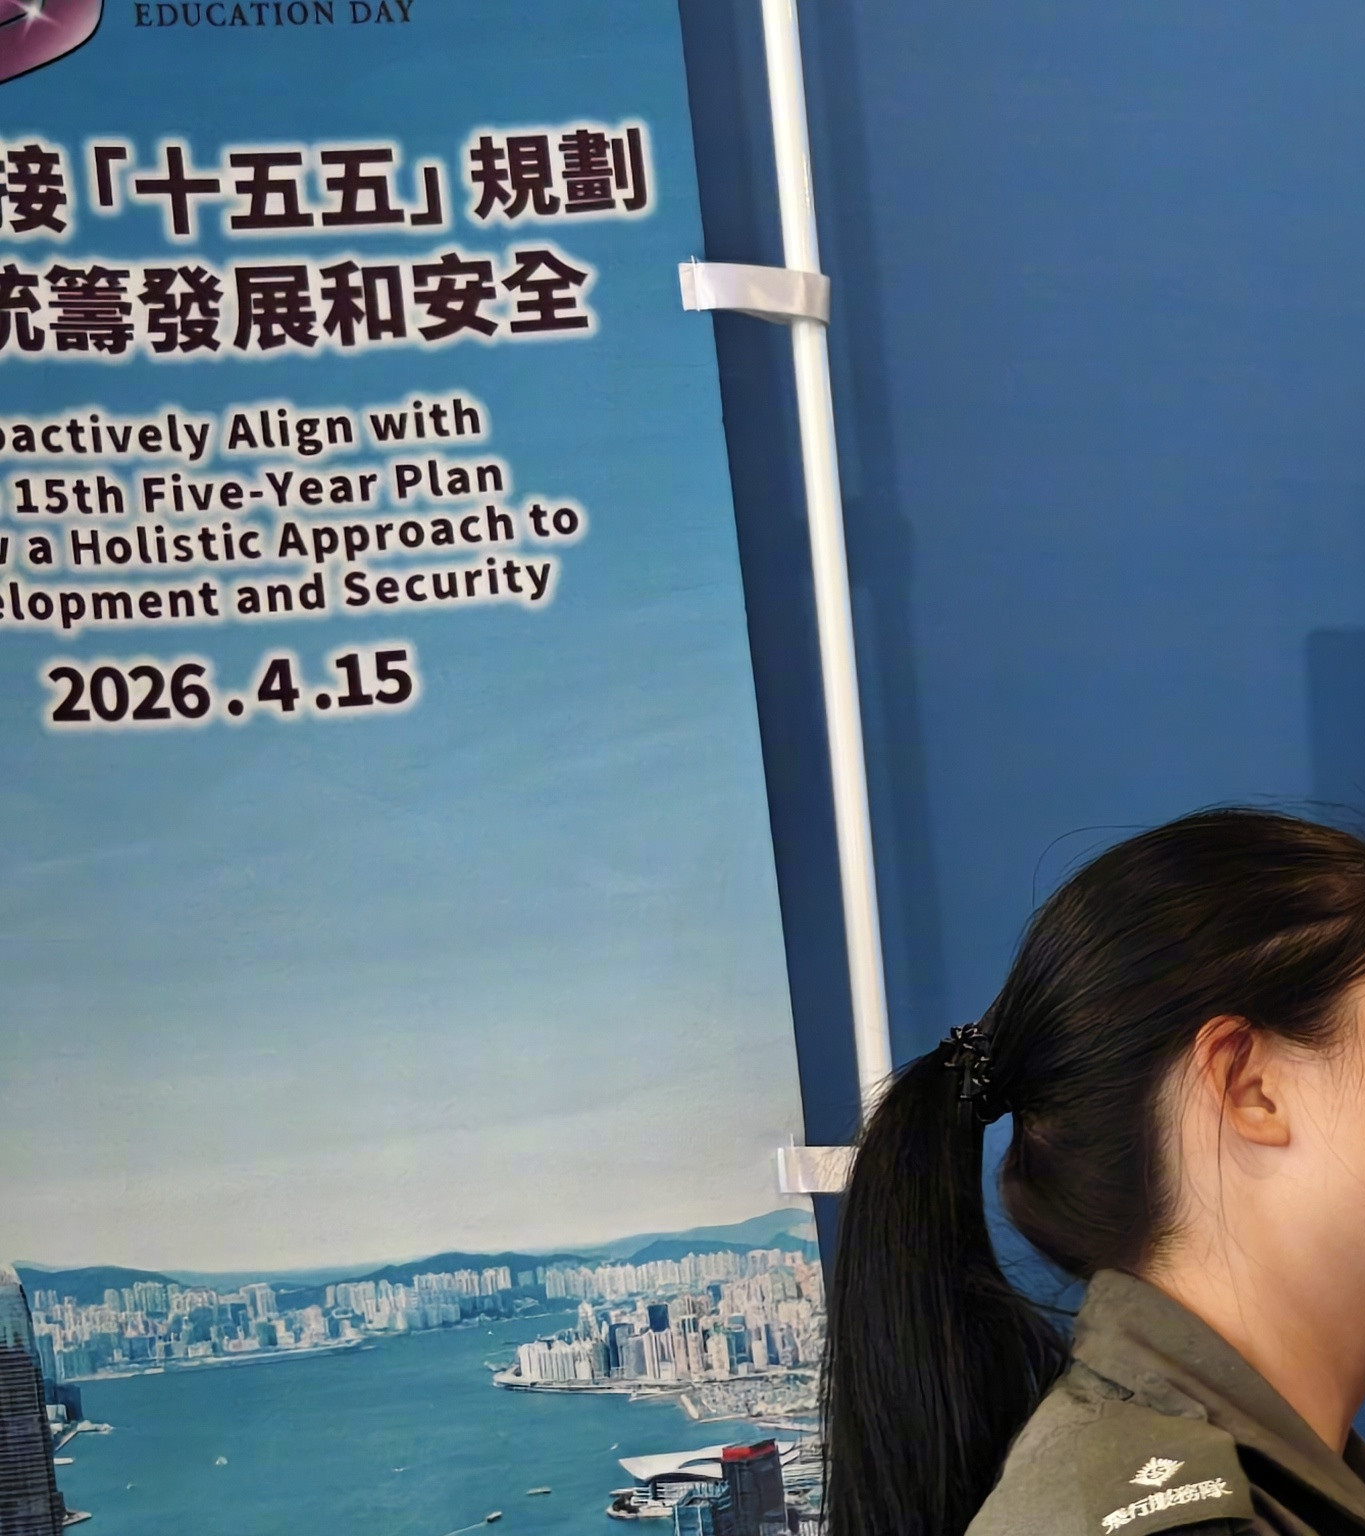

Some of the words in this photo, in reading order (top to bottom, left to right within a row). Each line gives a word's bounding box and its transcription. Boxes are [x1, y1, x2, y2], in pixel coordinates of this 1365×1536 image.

[135, 2, 335, 28] EDUCATION
[350, 0, 414, 25] DAY
[0, 413, 209, 461] actively
[228, 408, 353, 456] Align
[370, 398, 481, 441] with
[15, 475, 124, 514] 15th
[143, 471, 377, 513] Five-Year
[395, 459, 504, 499] Plan
[28, 536, 53, 565] a
[71, 522, 262, 565] Holistic
[278, 505, 515, 564] Approach
[529, 504, 579, 538] to
[0, 581, 220, 630] lopment
[237, 572, 326, 614] and
[343, 556, 551, 608] Security
[50, 650, 414, 723] 2026.4.15
